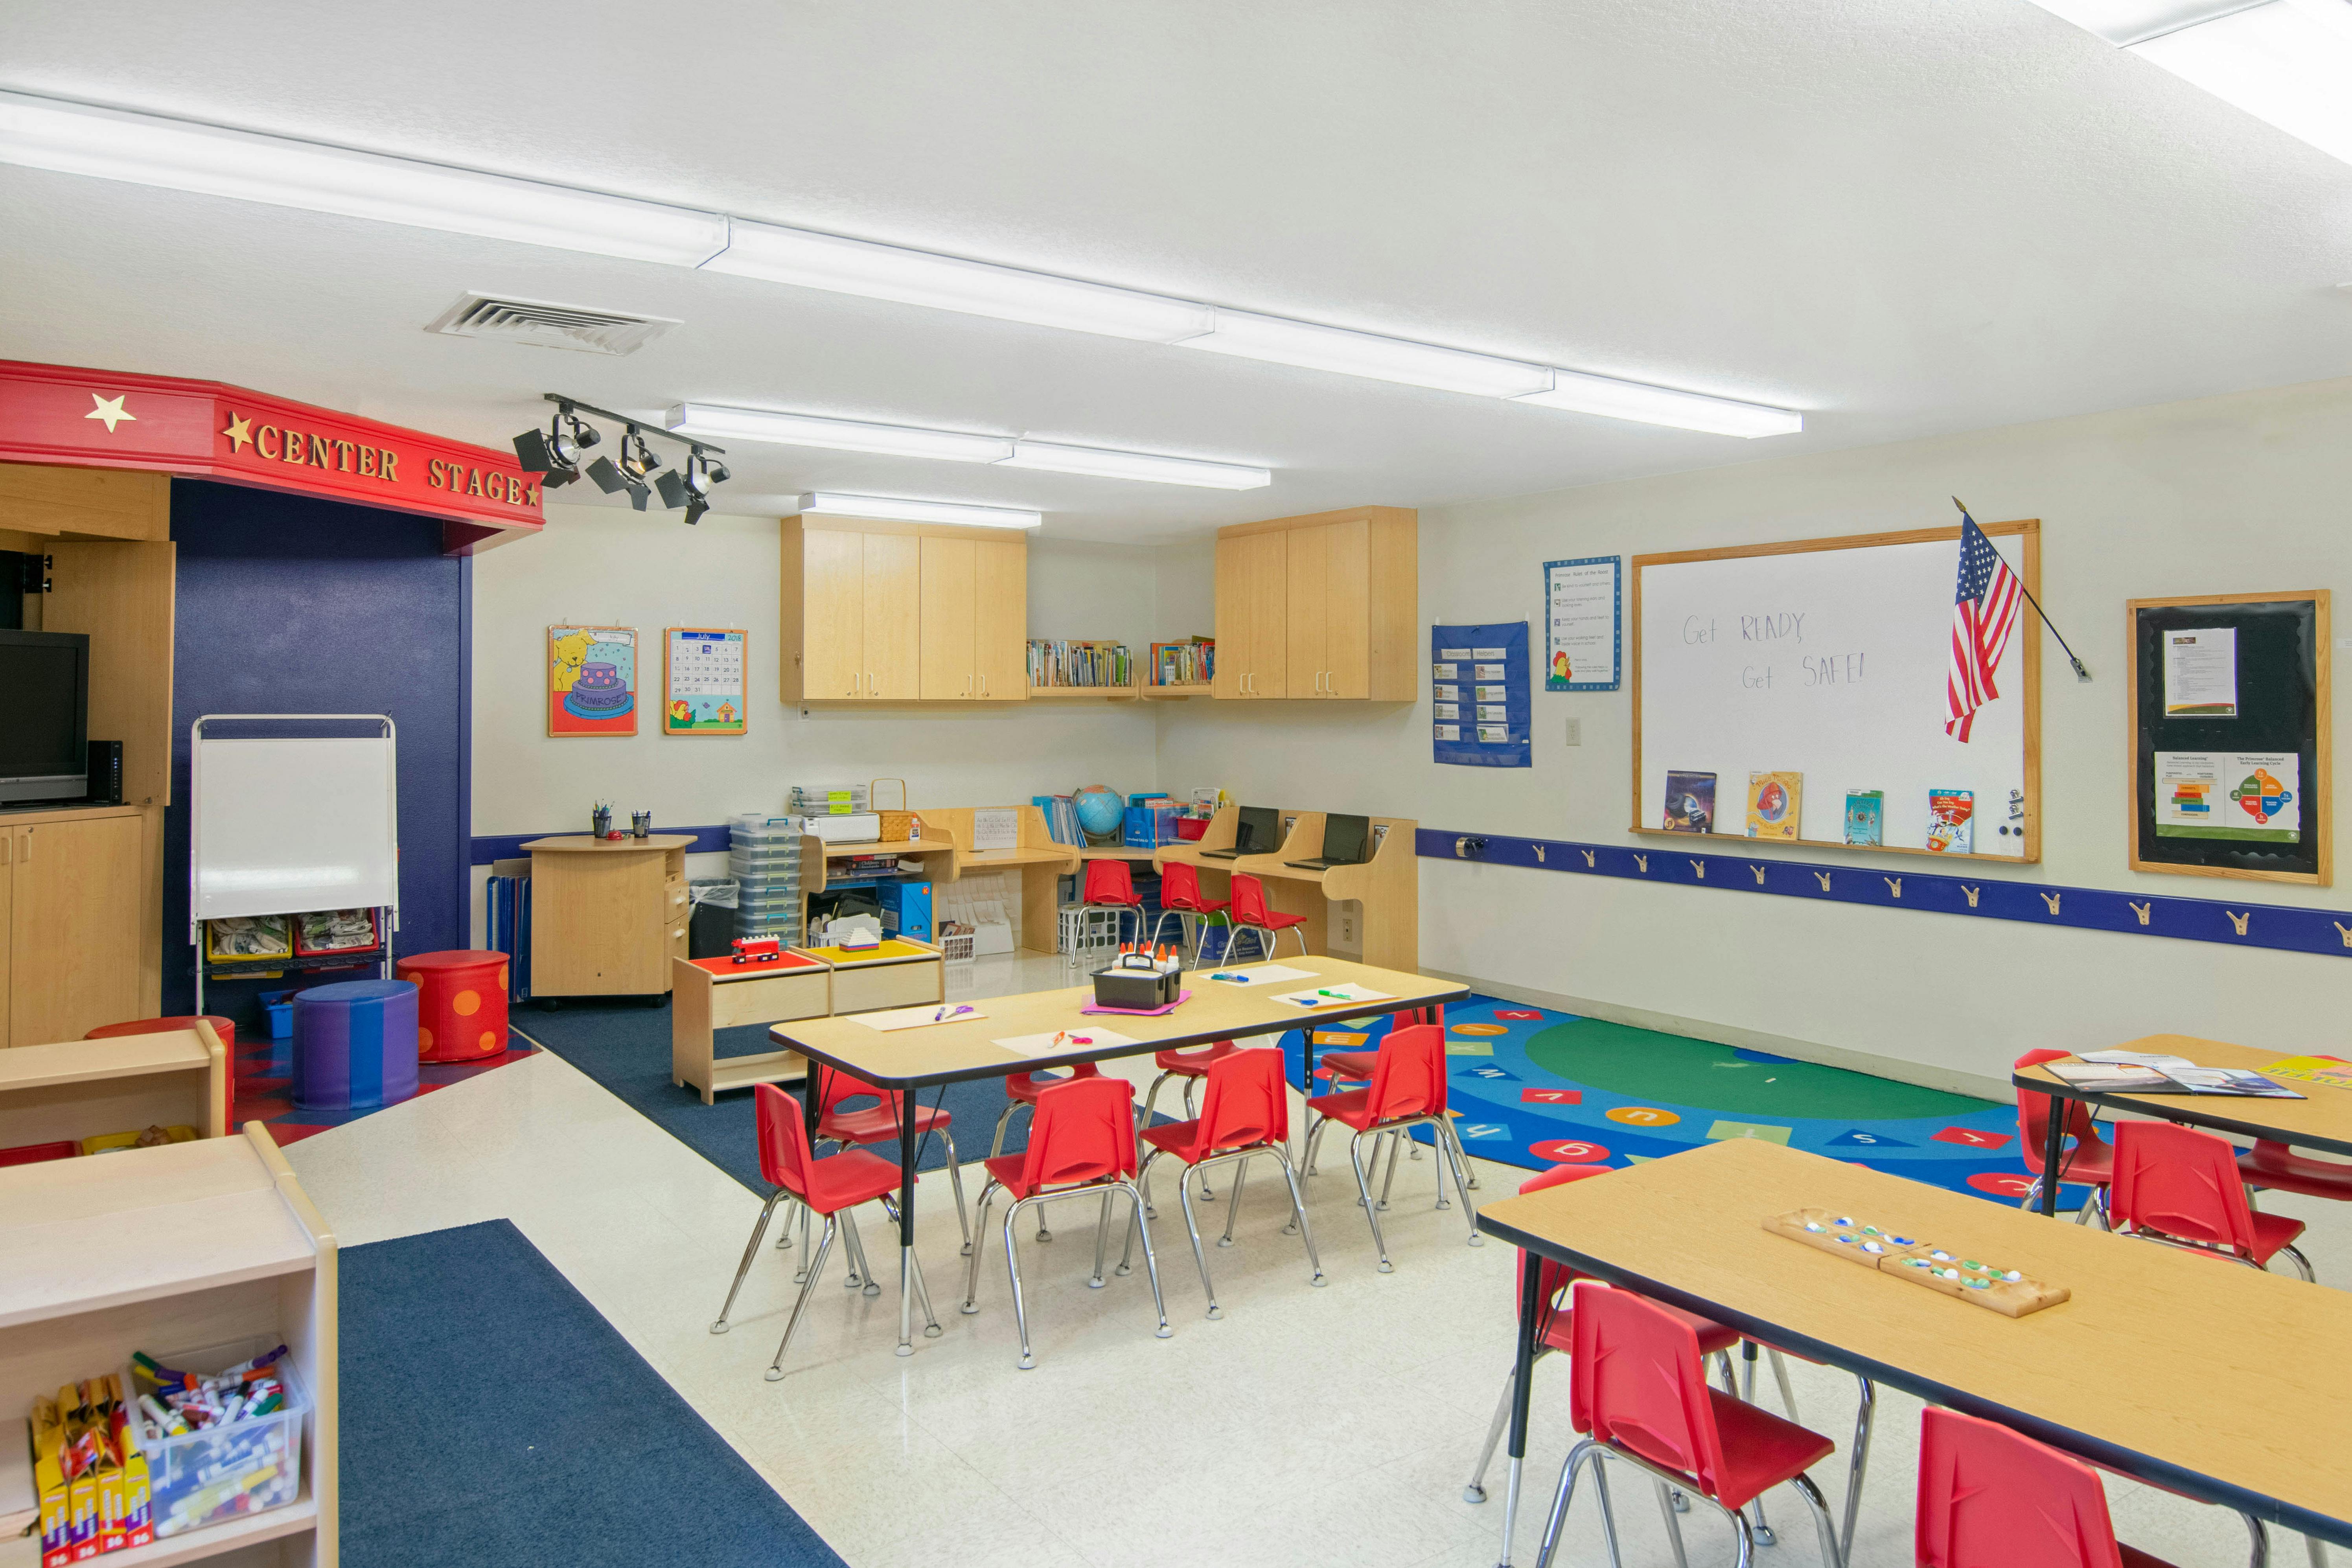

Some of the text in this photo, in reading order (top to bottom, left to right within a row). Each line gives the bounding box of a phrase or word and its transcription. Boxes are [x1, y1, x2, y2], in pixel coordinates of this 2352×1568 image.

[255, 425, 521, 505] CENTER STAGE
[1683, 615, 1717, 644] Get
[1742, 652, 1864, 689] Get SAFE!
